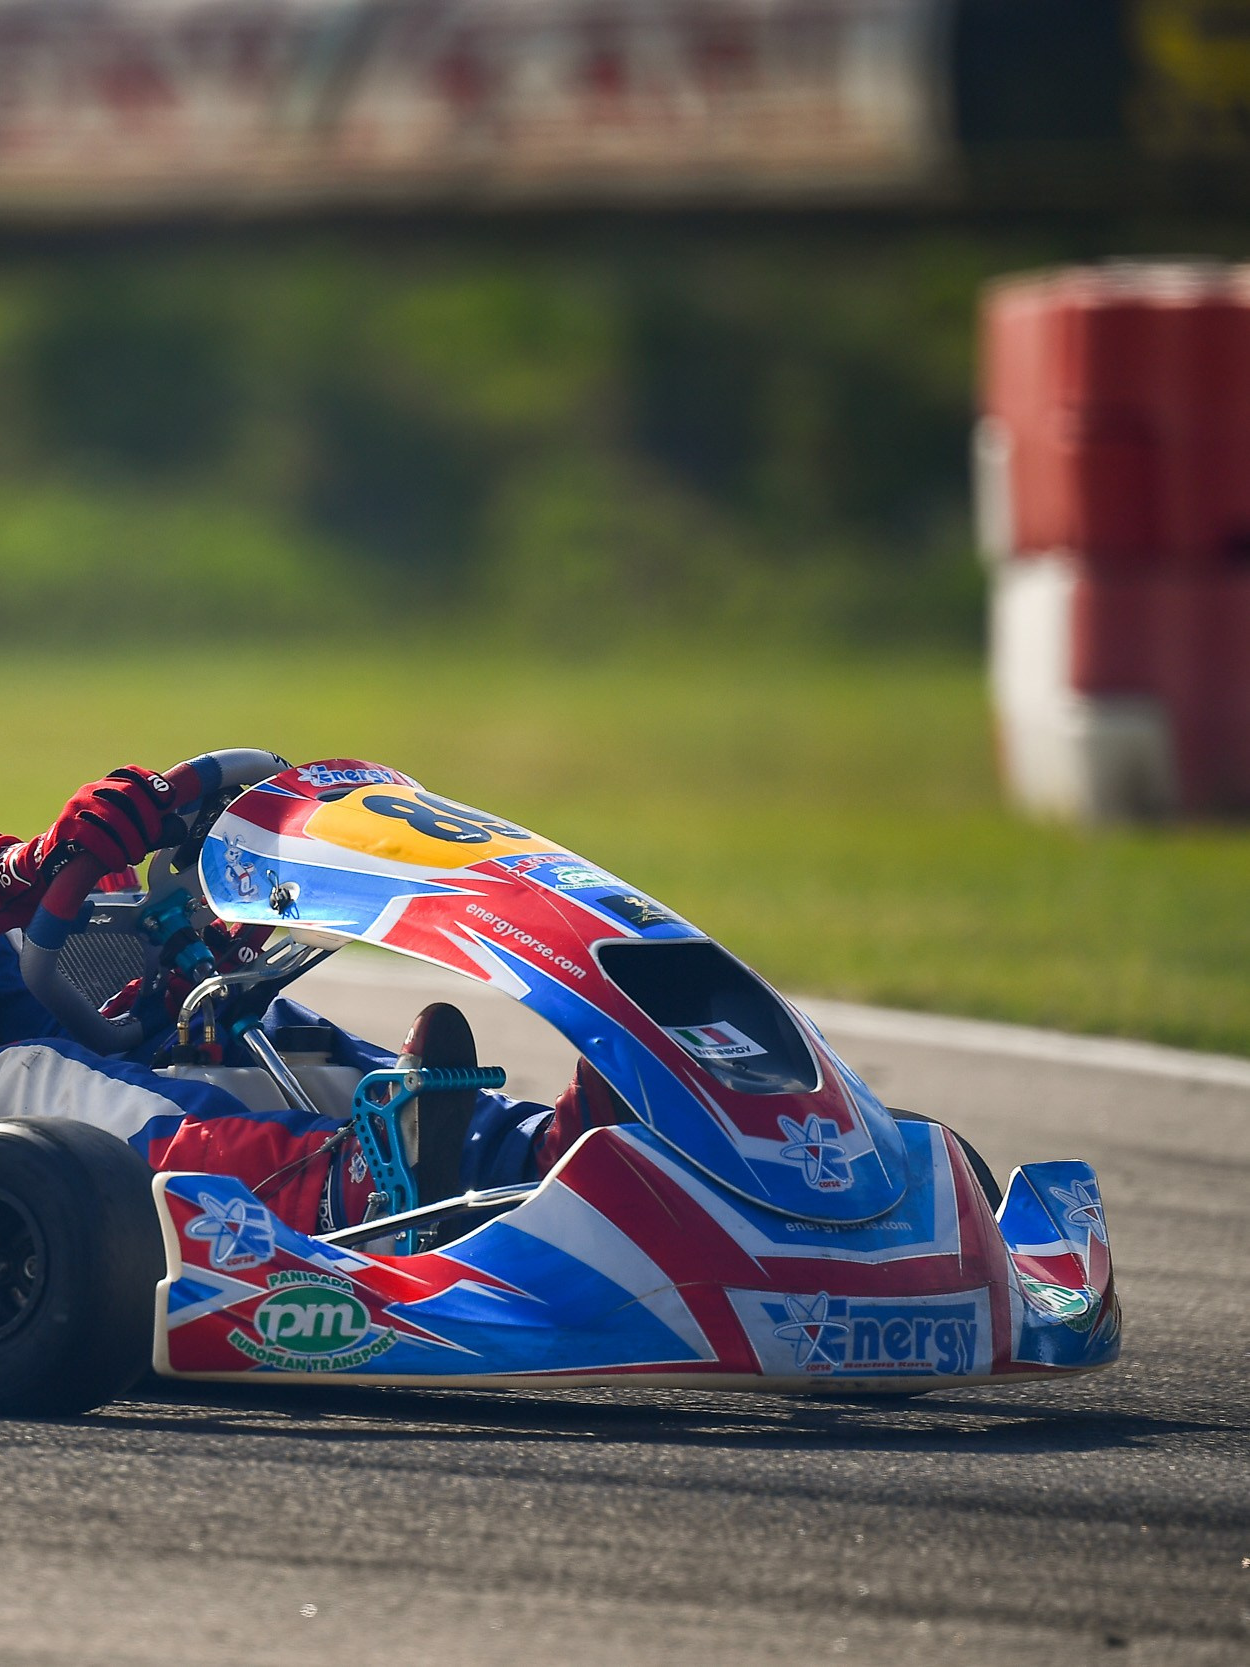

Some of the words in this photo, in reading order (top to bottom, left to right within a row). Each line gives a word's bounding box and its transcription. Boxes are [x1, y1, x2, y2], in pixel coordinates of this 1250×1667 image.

[316, 765, 394, 784] Energy
[465, 903, 588, 980] energycorse.com
[818, 1180, 841, 1188] corse
[268, 1271, 354, 1294] PANIGADA
[260, 1303, 366, 1347] pm
[810, 1300, 977, 1376] Energy
[228, 1331, 308, 1371] EUROPEAN
[310, 1329, 399, 1371] TRANSPORT
